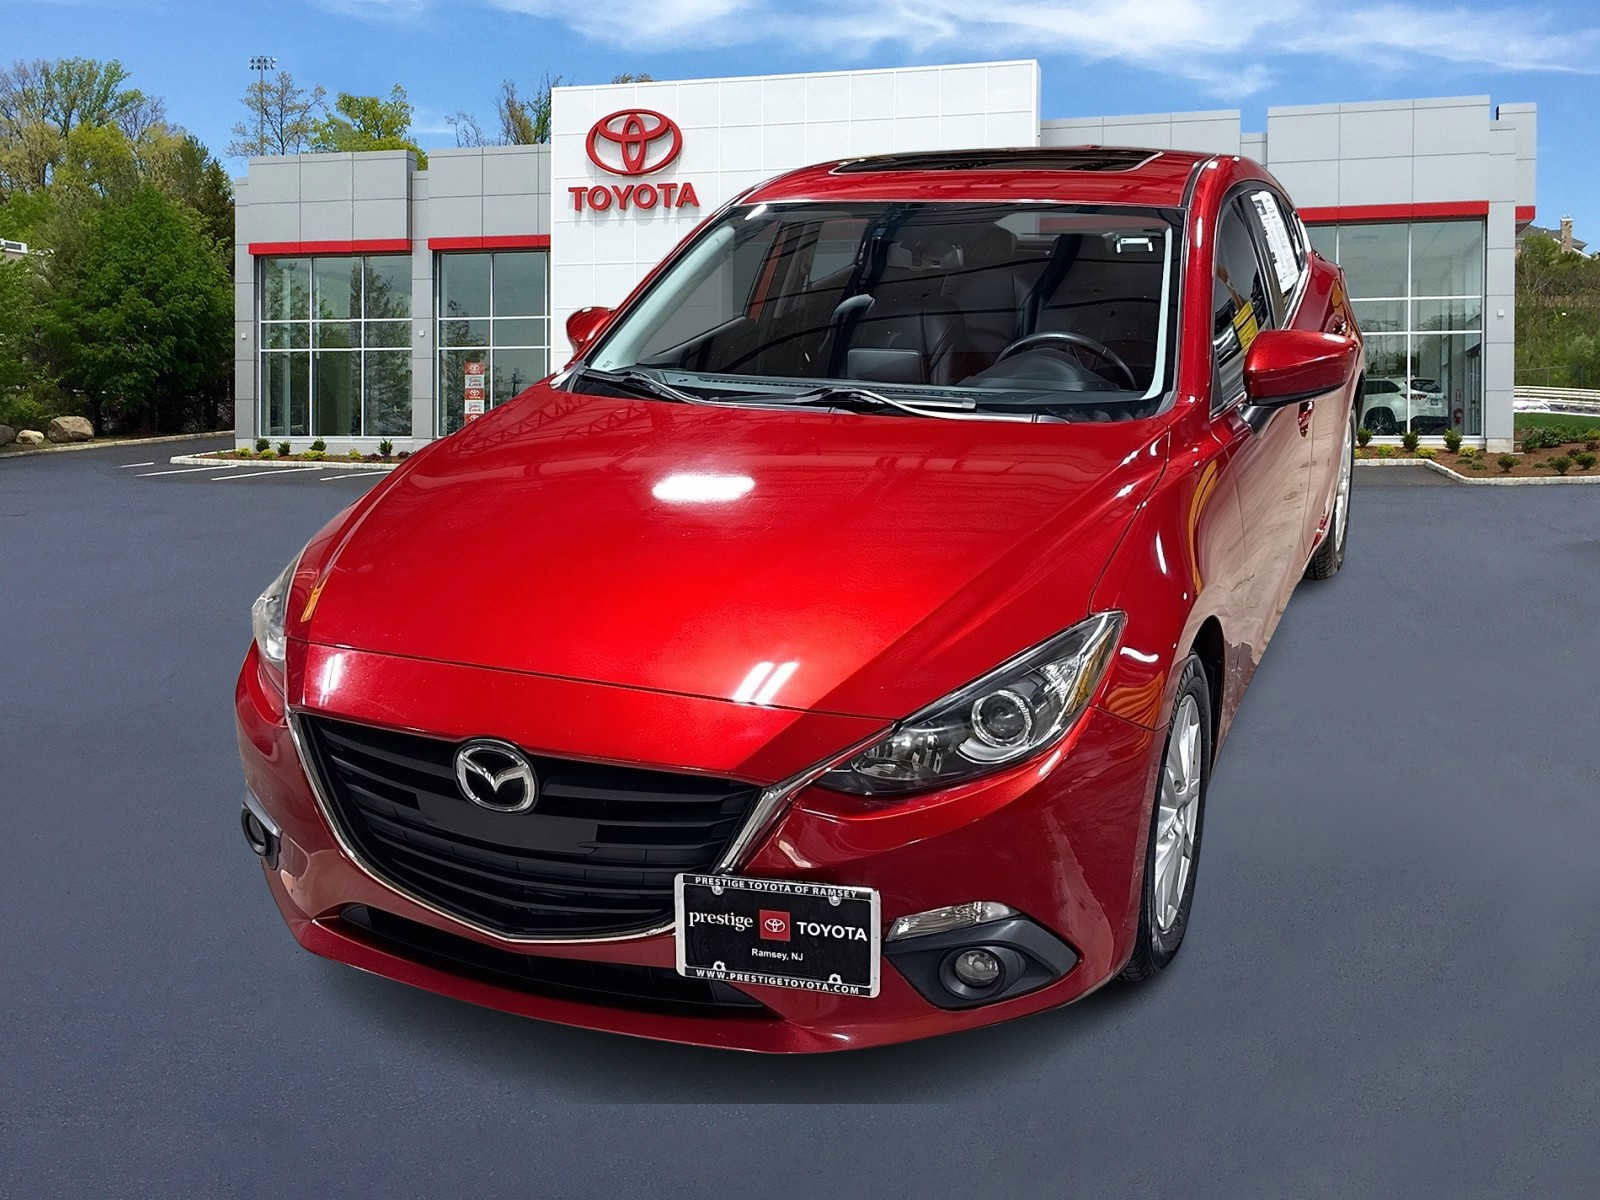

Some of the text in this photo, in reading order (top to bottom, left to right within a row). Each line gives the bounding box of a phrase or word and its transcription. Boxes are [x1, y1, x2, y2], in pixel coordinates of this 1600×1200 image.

[568, 182, 700, 211] TOYOTA
[695, 877, 857, 898] PRESTIGE TOYOTA OF RAMSEY
[688, 911, 868, 942] prestige TOYOTA
[751, 948, 804, 961] Ramsey, NJ
[695, 969, 860, 995] WWW.PRESTIGETOYOTA.COM
